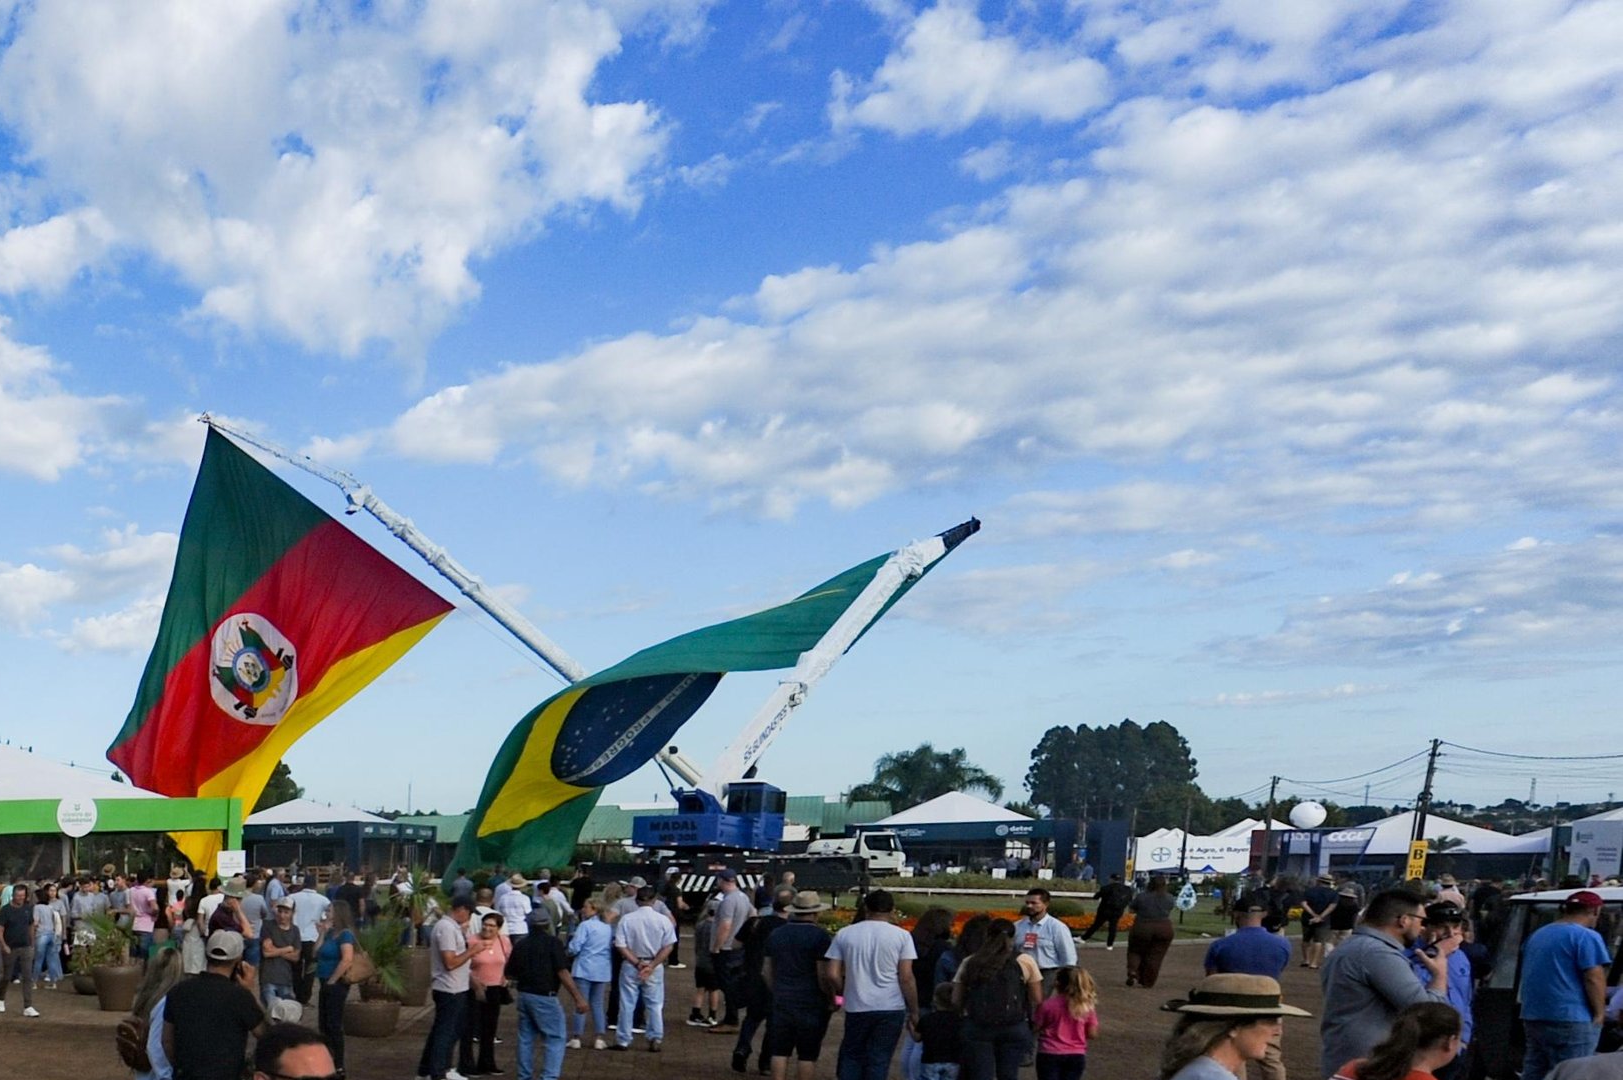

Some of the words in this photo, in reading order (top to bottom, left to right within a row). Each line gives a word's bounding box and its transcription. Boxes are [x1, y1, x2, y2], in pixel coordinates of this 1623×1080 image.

[271, 825, 305, 836] Produção
[307, 825, 334, 836] Vegetal
[649, 820, 697, 832] MADAL
[1328, 831, 1364, 842] CCGL
[1413, 849, 1424, 860] B
